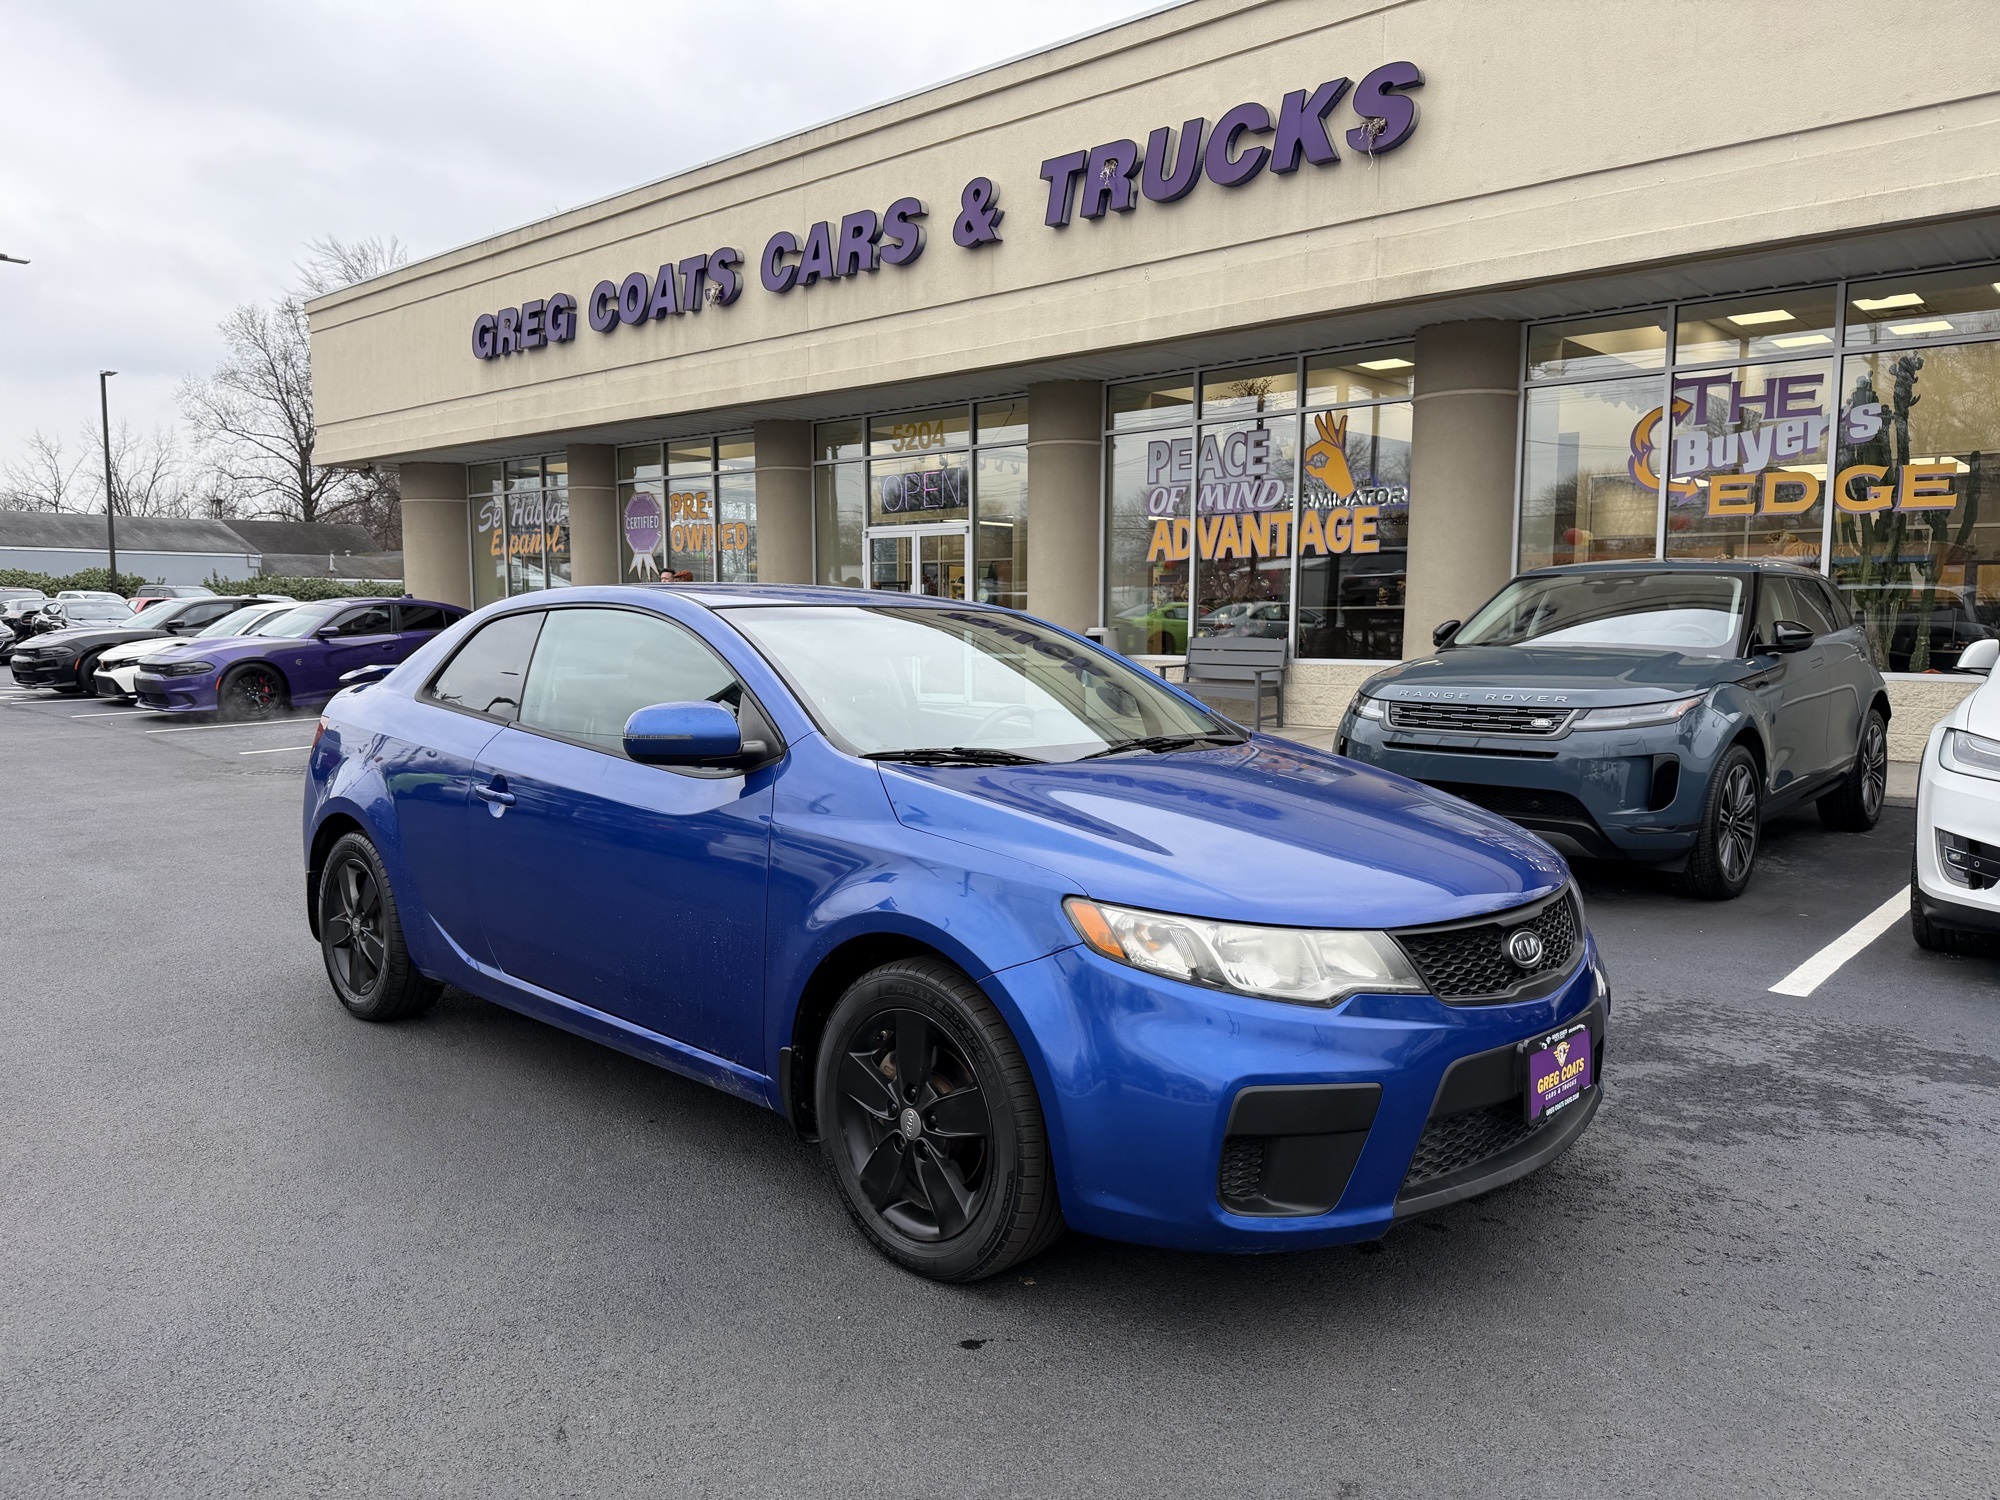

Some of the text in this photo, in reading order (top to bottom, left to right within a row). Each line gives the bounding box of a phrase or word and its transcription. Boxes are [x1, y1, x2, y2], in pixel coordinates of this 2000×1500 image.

[472, 61, 1426, 360] GREG COATS CARS & TRUCKS
[1673, 372, 1825, 428] THE
[892, 419, 946, 452] 5204
[1147, 429, 1270, 485] PEACE
[883, 468, 961, 511] OPEN
[1148, 480, 1286, 515] OF MIND
[1356, 478, 1372, 487] HE
[1703, 462, 1959, 518] EDGE
[478, 500, 501, 533] Se
[626, 515, 659, 530] CERTIFIED
[1146, 506, 1380, 562] ADVANTAGE
[1398, 689, 1569, 703] RANGE ROVER
[1514, 937, 1539, 959] KIA
[1537, 1057, 1585, 1094] GREG COATS
[1545, 1089, 1557, 1101] CARS
